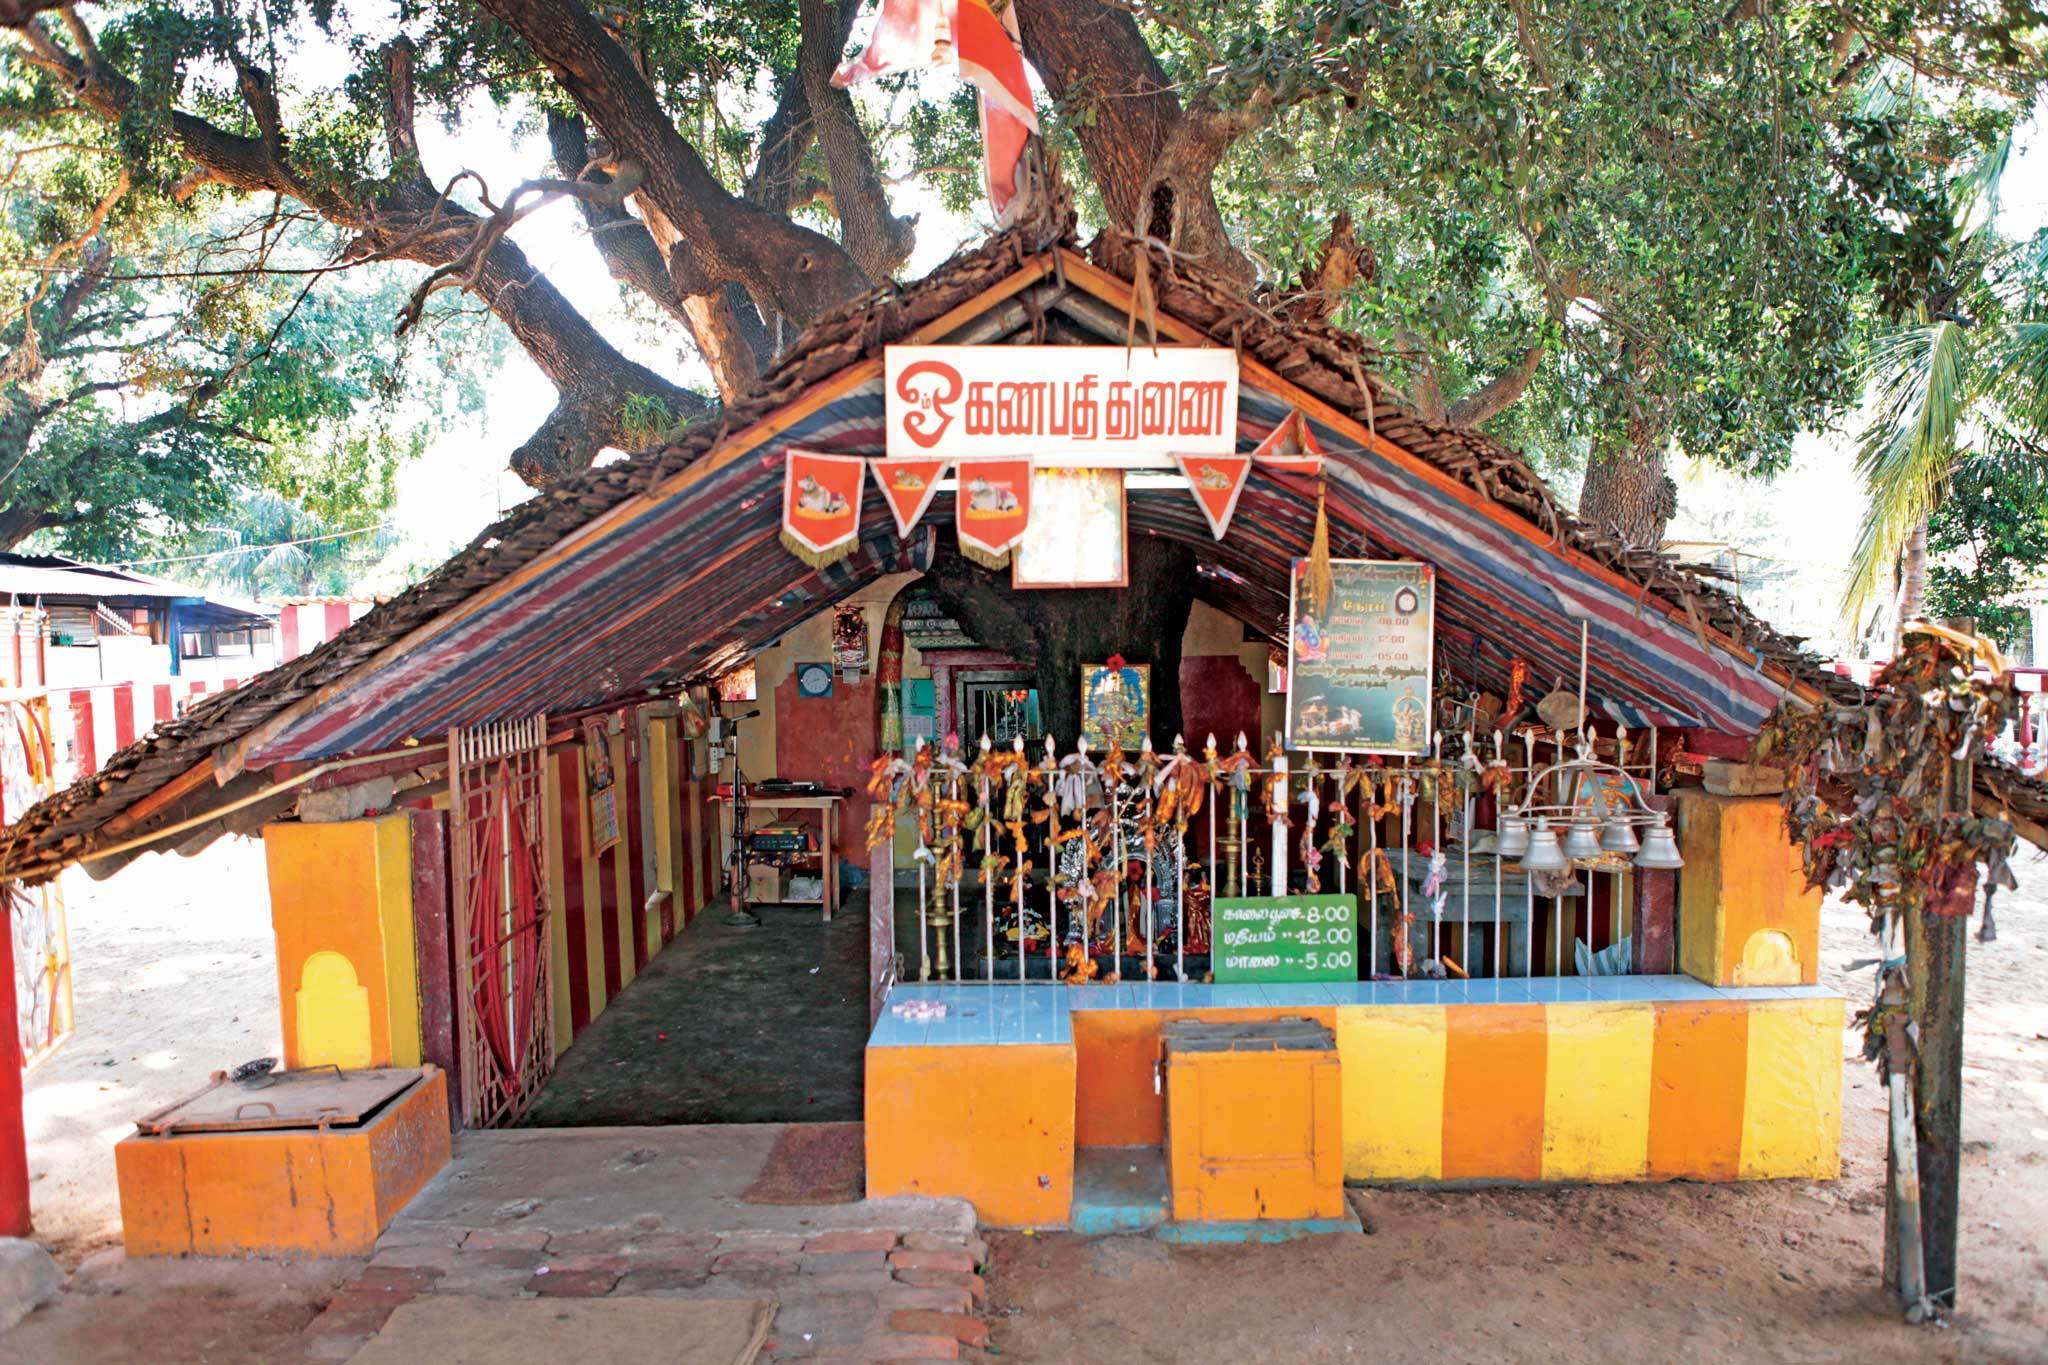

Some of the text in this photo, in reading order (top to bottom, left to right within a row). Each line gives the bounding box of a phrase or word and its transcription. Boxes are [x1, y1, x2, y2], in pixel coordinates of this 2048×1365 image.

[964, 374, 1099, 440] கணபதி
[1106, 380, 1227, 440] துணை
[1222, 907, 1268, 921] காலை
[1223, 926, 1276, 946] மதியம்
[1225, 955, 1280, 968] மாலை
